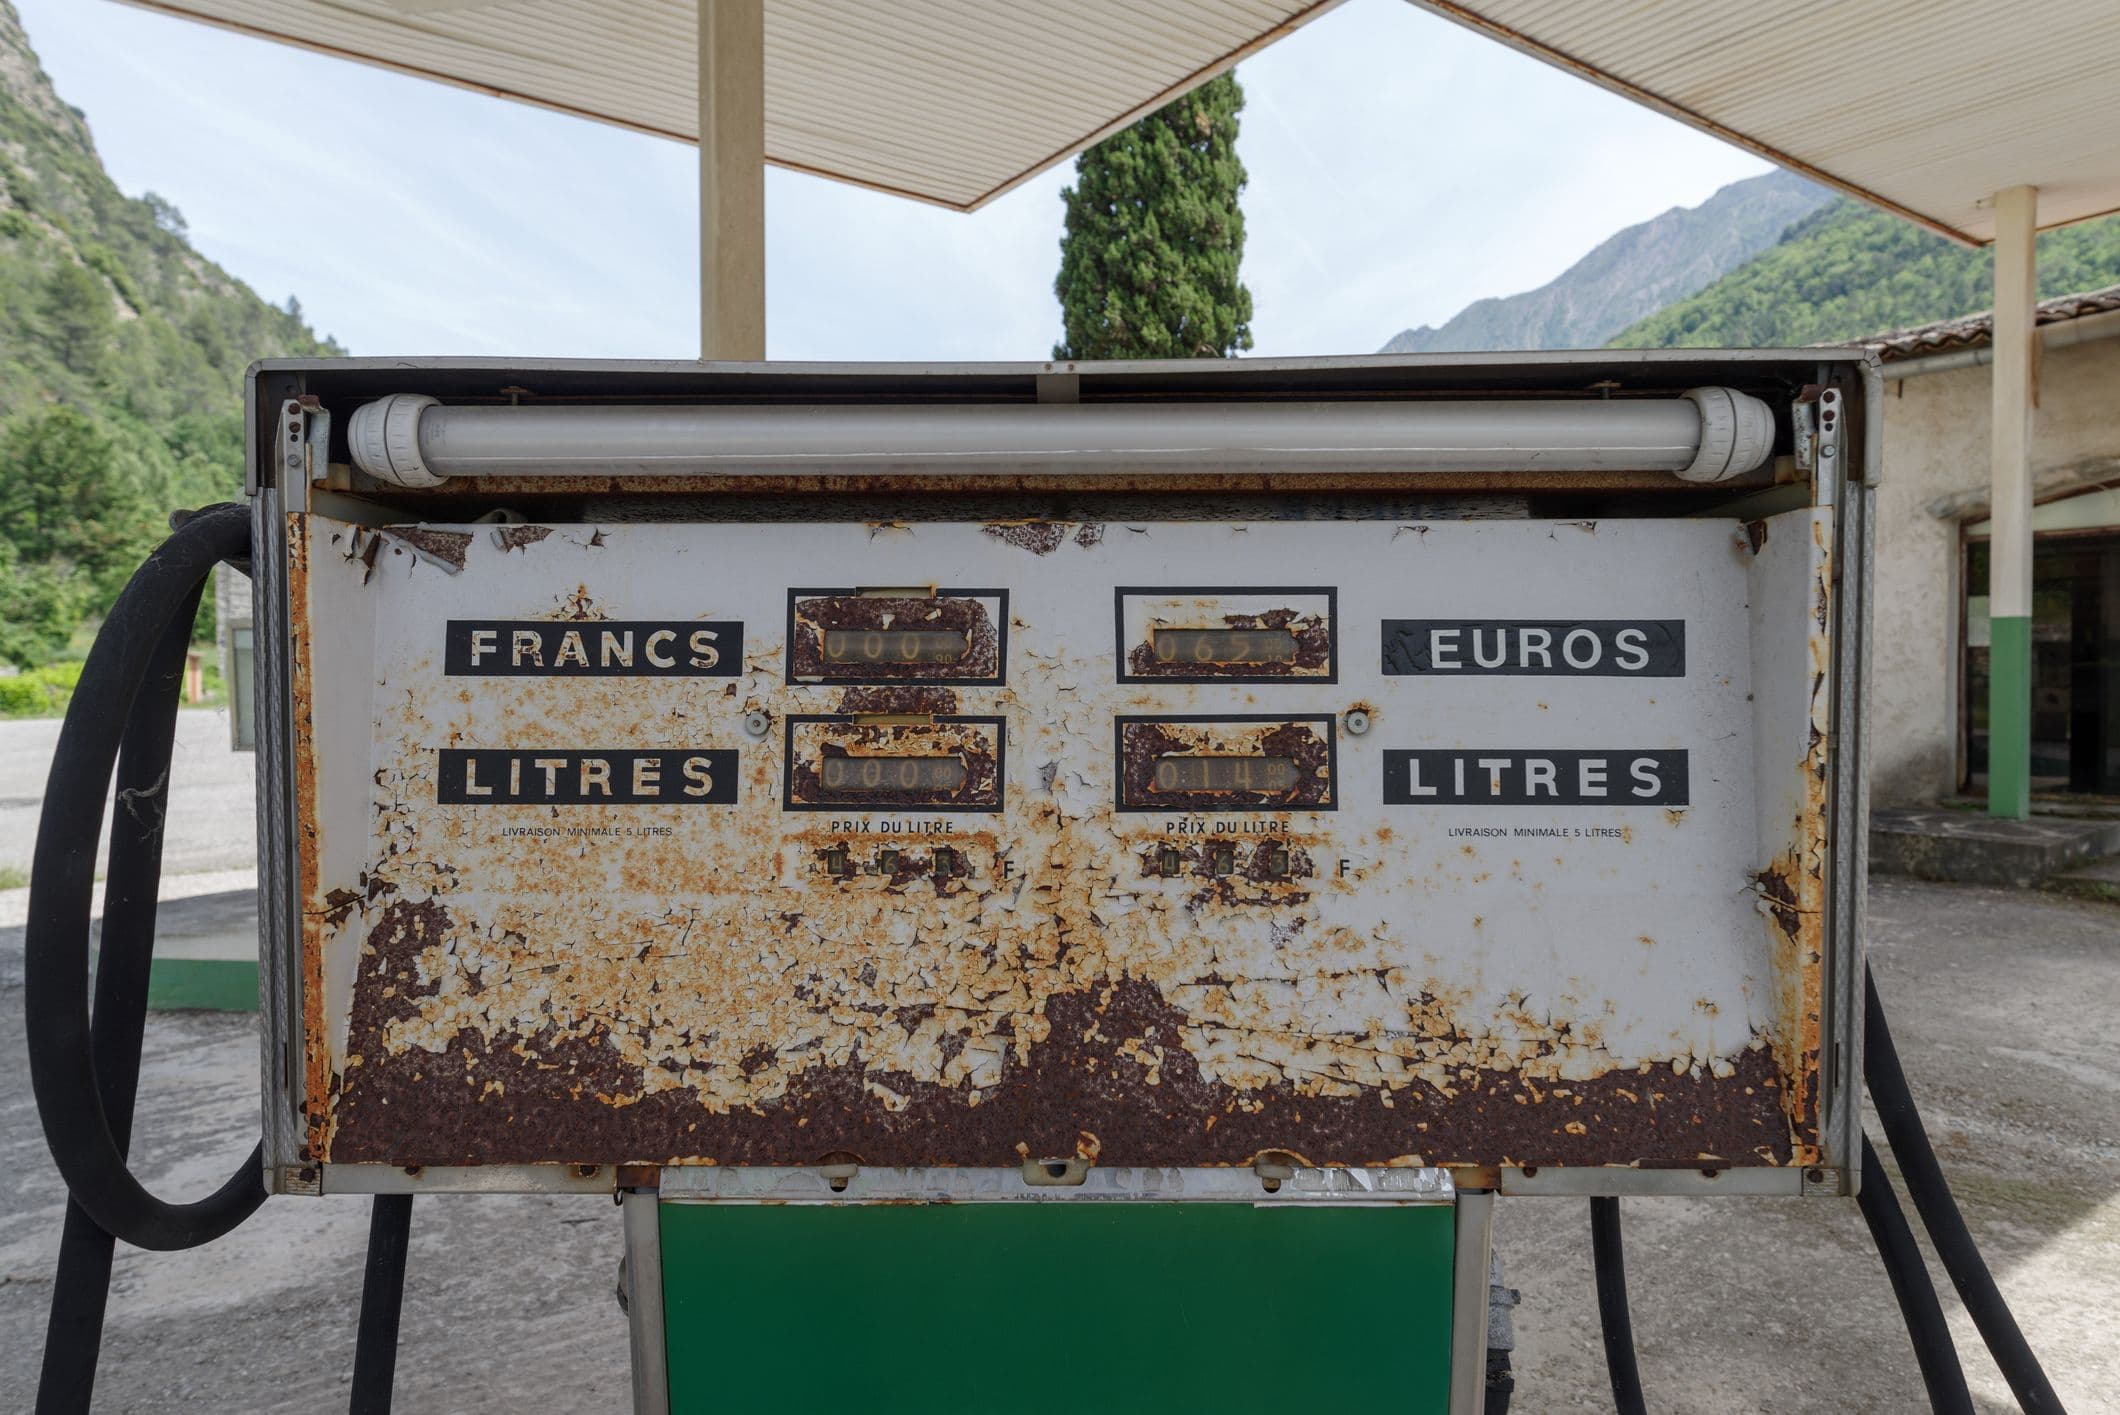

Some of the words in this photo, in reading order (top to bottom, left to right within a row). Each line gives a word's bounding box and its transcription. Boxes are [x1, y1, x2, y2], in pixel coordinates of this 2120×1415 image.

[470, 629, 720, 669] FRANCS
[1429, 628, 1650, 670] EUROS
[465, 756, 713, 797] LITRES
[1409, 757, 1662, 797] LITRES
[502, 826, 560, 838] LIVRAISON
[567, 826, 620, 838] MINIMALE
[626, 826, 633, 838] 5
[637, 826, 673, 838] LITRES
[831, 820, 871, 834] PRIX
[881, 821, 902, 834] DU
[908, 821, 954, 834] LITRE
[1166, 821, 1206, 835] PRIX
[1216, 821, 1238, 835] DU
[1243, 821, 1290, 835] LITRE
[1448, 827, 1507, 838] LIVRAISON
[1514, 827, 1569, 838] MINIMALE
[1574, 827, 1581, 838] 5
[1585, 827, 1622, 838] LITRES
[1339, 859, 1350, 878] F
